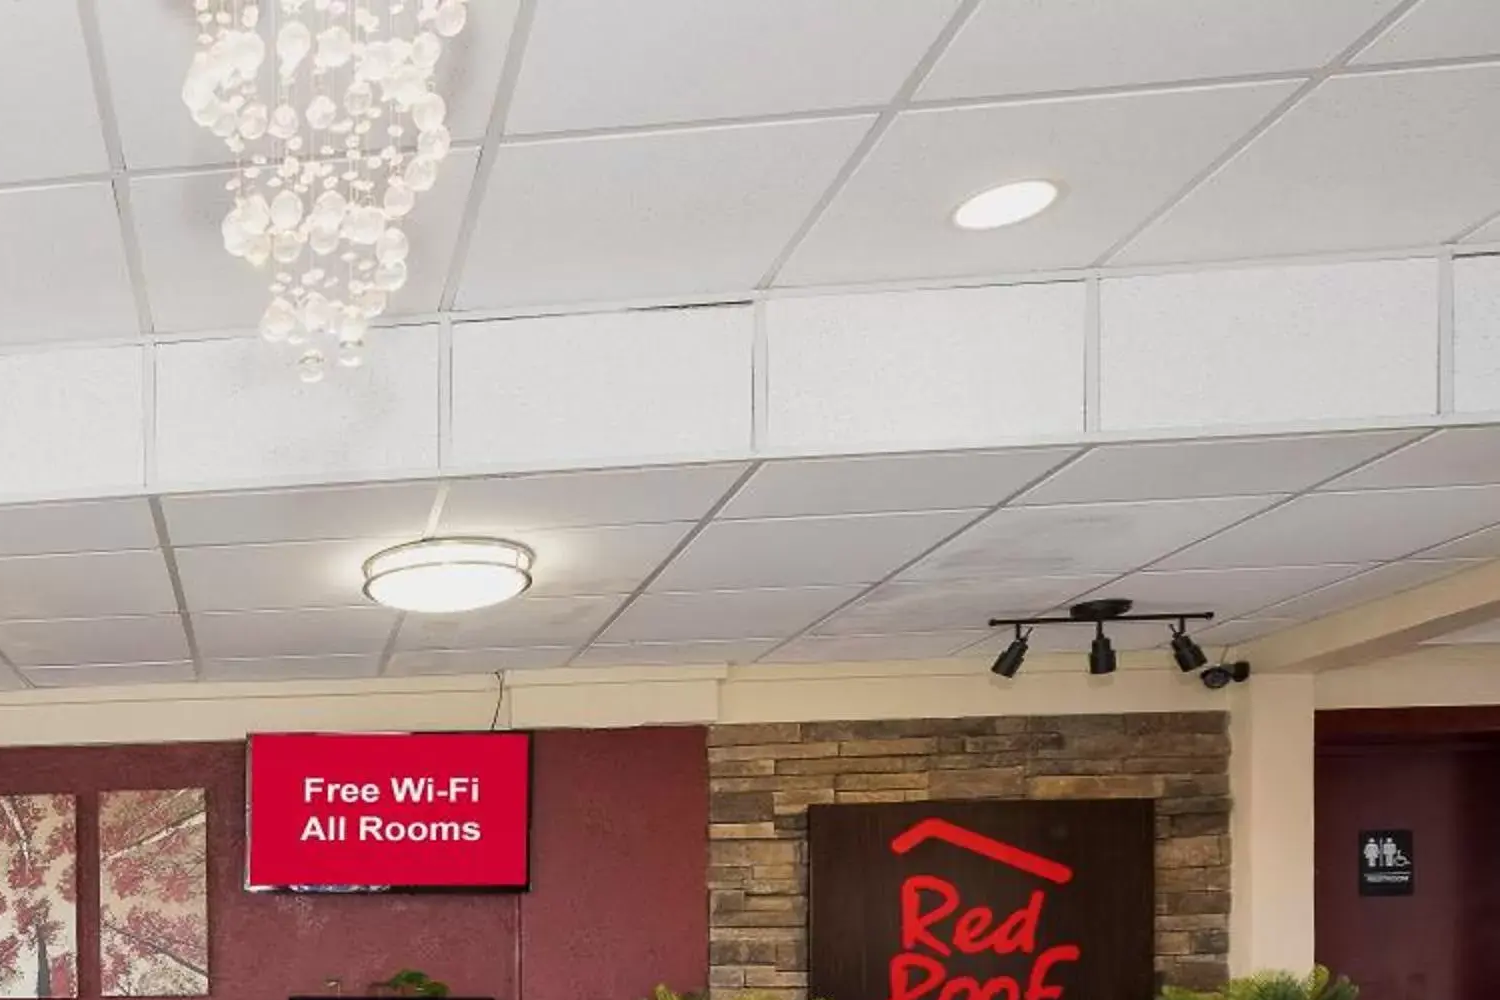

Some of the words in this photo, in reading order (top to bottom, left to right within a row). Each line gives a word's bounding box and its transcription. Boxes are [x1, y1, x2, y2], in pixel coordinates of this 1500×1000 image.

[304, 777, 381, 803] Free
[390, 777, 480, 803] Wi-Fi
[300, 815, 347, 841] All
[359, 815, 482, 841] Rooms
[901, 875, 1045, 956] Red
